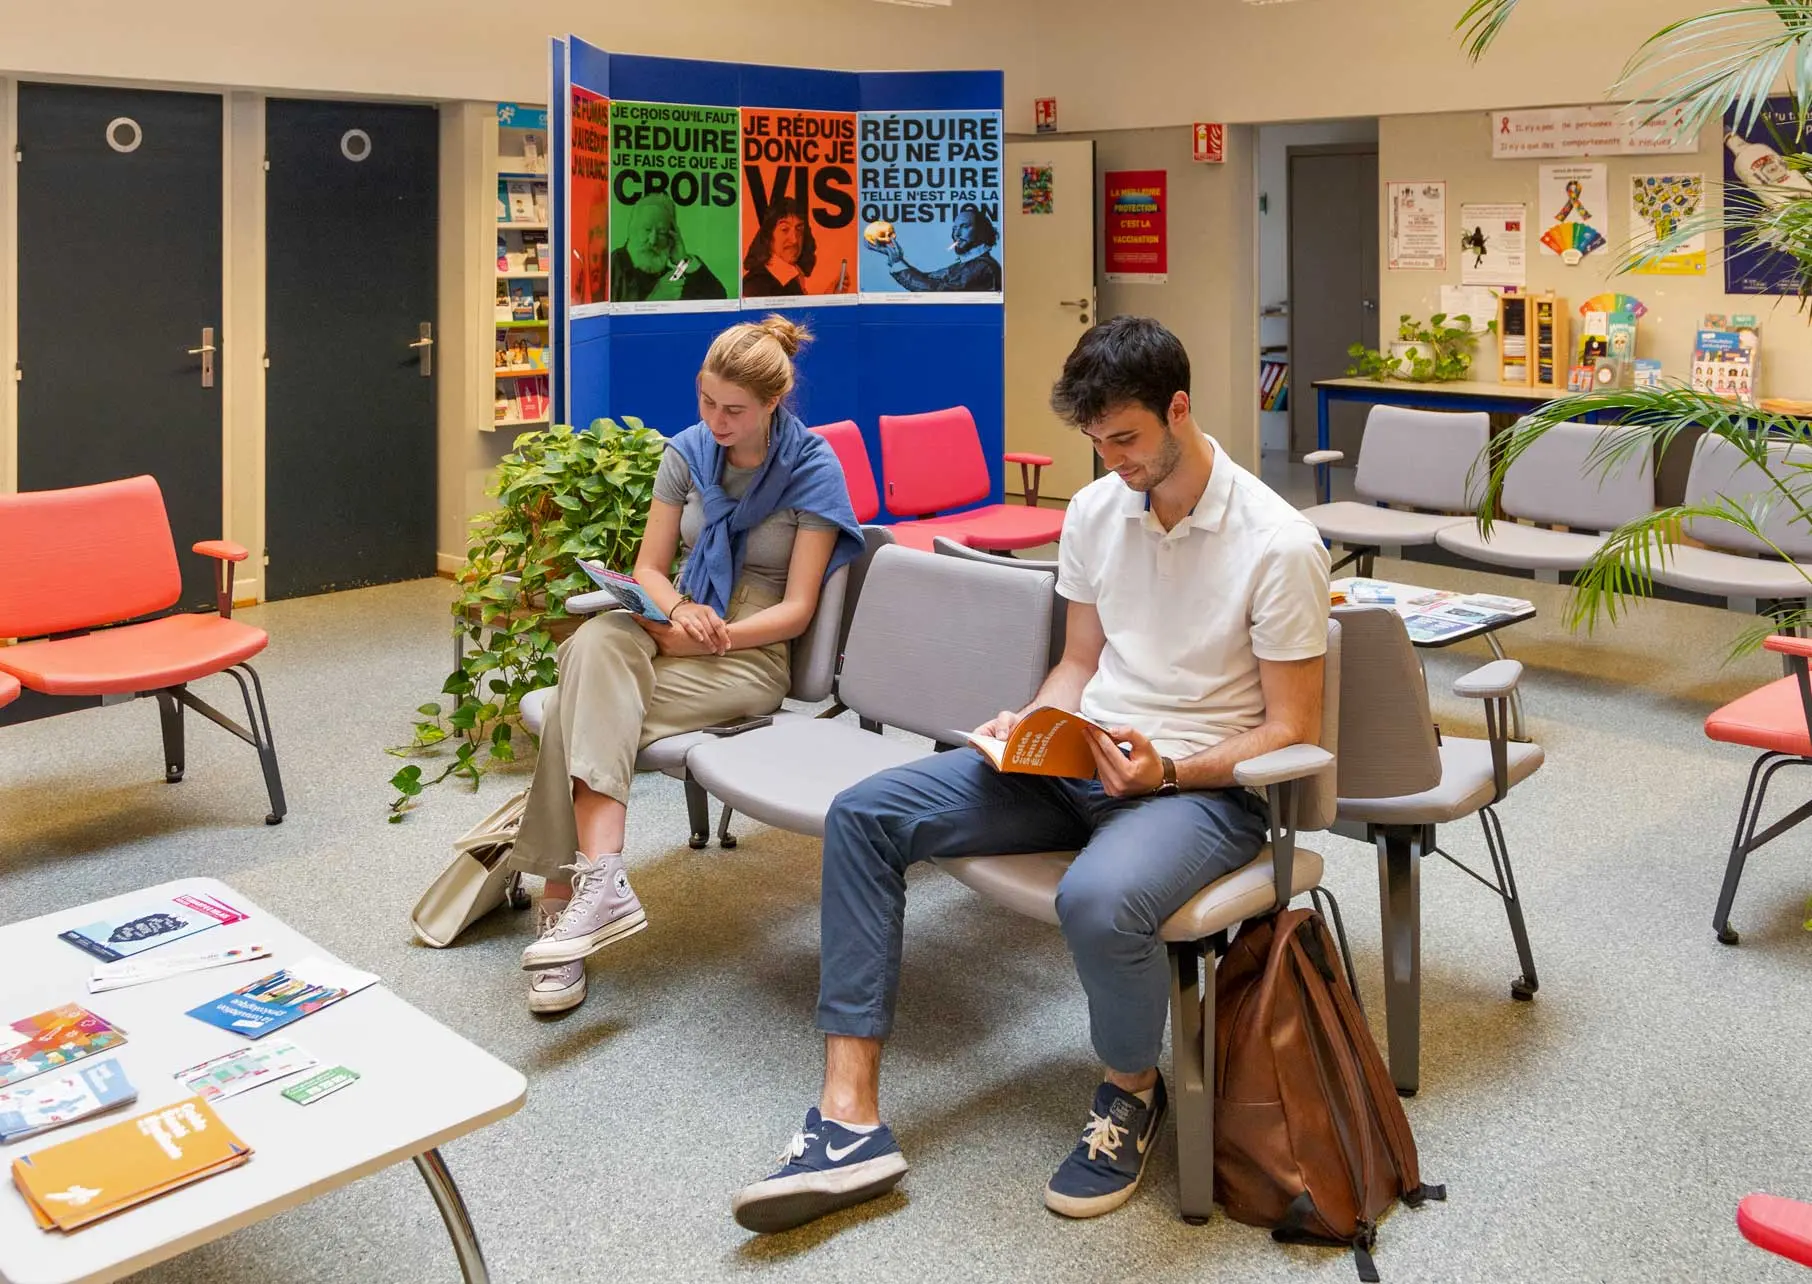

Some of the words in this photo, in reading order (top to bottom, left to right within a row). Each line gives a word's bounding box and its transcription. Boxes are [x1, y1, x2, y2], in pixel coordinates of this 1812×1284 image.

[612, 106, 628, 118] JE
[630, 107, 670, 120] CROIS
[672, 110, 704, 122] QU'IL
[705, 112, 736, 124] FAUT
[744, 116, 770, 136] JE
[777, 112, 854, 139] RÉDUIS
[862, 114, 998, 140] RÉDUIRE
[613, 120, 736, 154] RÉDUIRE
[613, 154, 630, 166] JE
[634, 155, 665, 168] FAIS
[667, 156, 686, 168] CE
[689, 156, 718, 170] QUE
[721, 157, 737, 170] JE
[744, 138, 820, 164] DONC
[824, 140, 854, 164] JE
[861, 143, 898, 162] OU
[906, 143, 940, 162] NE
[948, 142, 998, 162] PAS
[614, 168, 737, 207] CROIS
[862, 163, 998, 188] RÉDUIRE
[744, 165, 855, 229] VIS
[861, 191, 902, 201] TELLE
[907, 190, 946, 201] N'EST
[950, 190, 976, 200] PAS
[982, 190, 998, 200] LA
